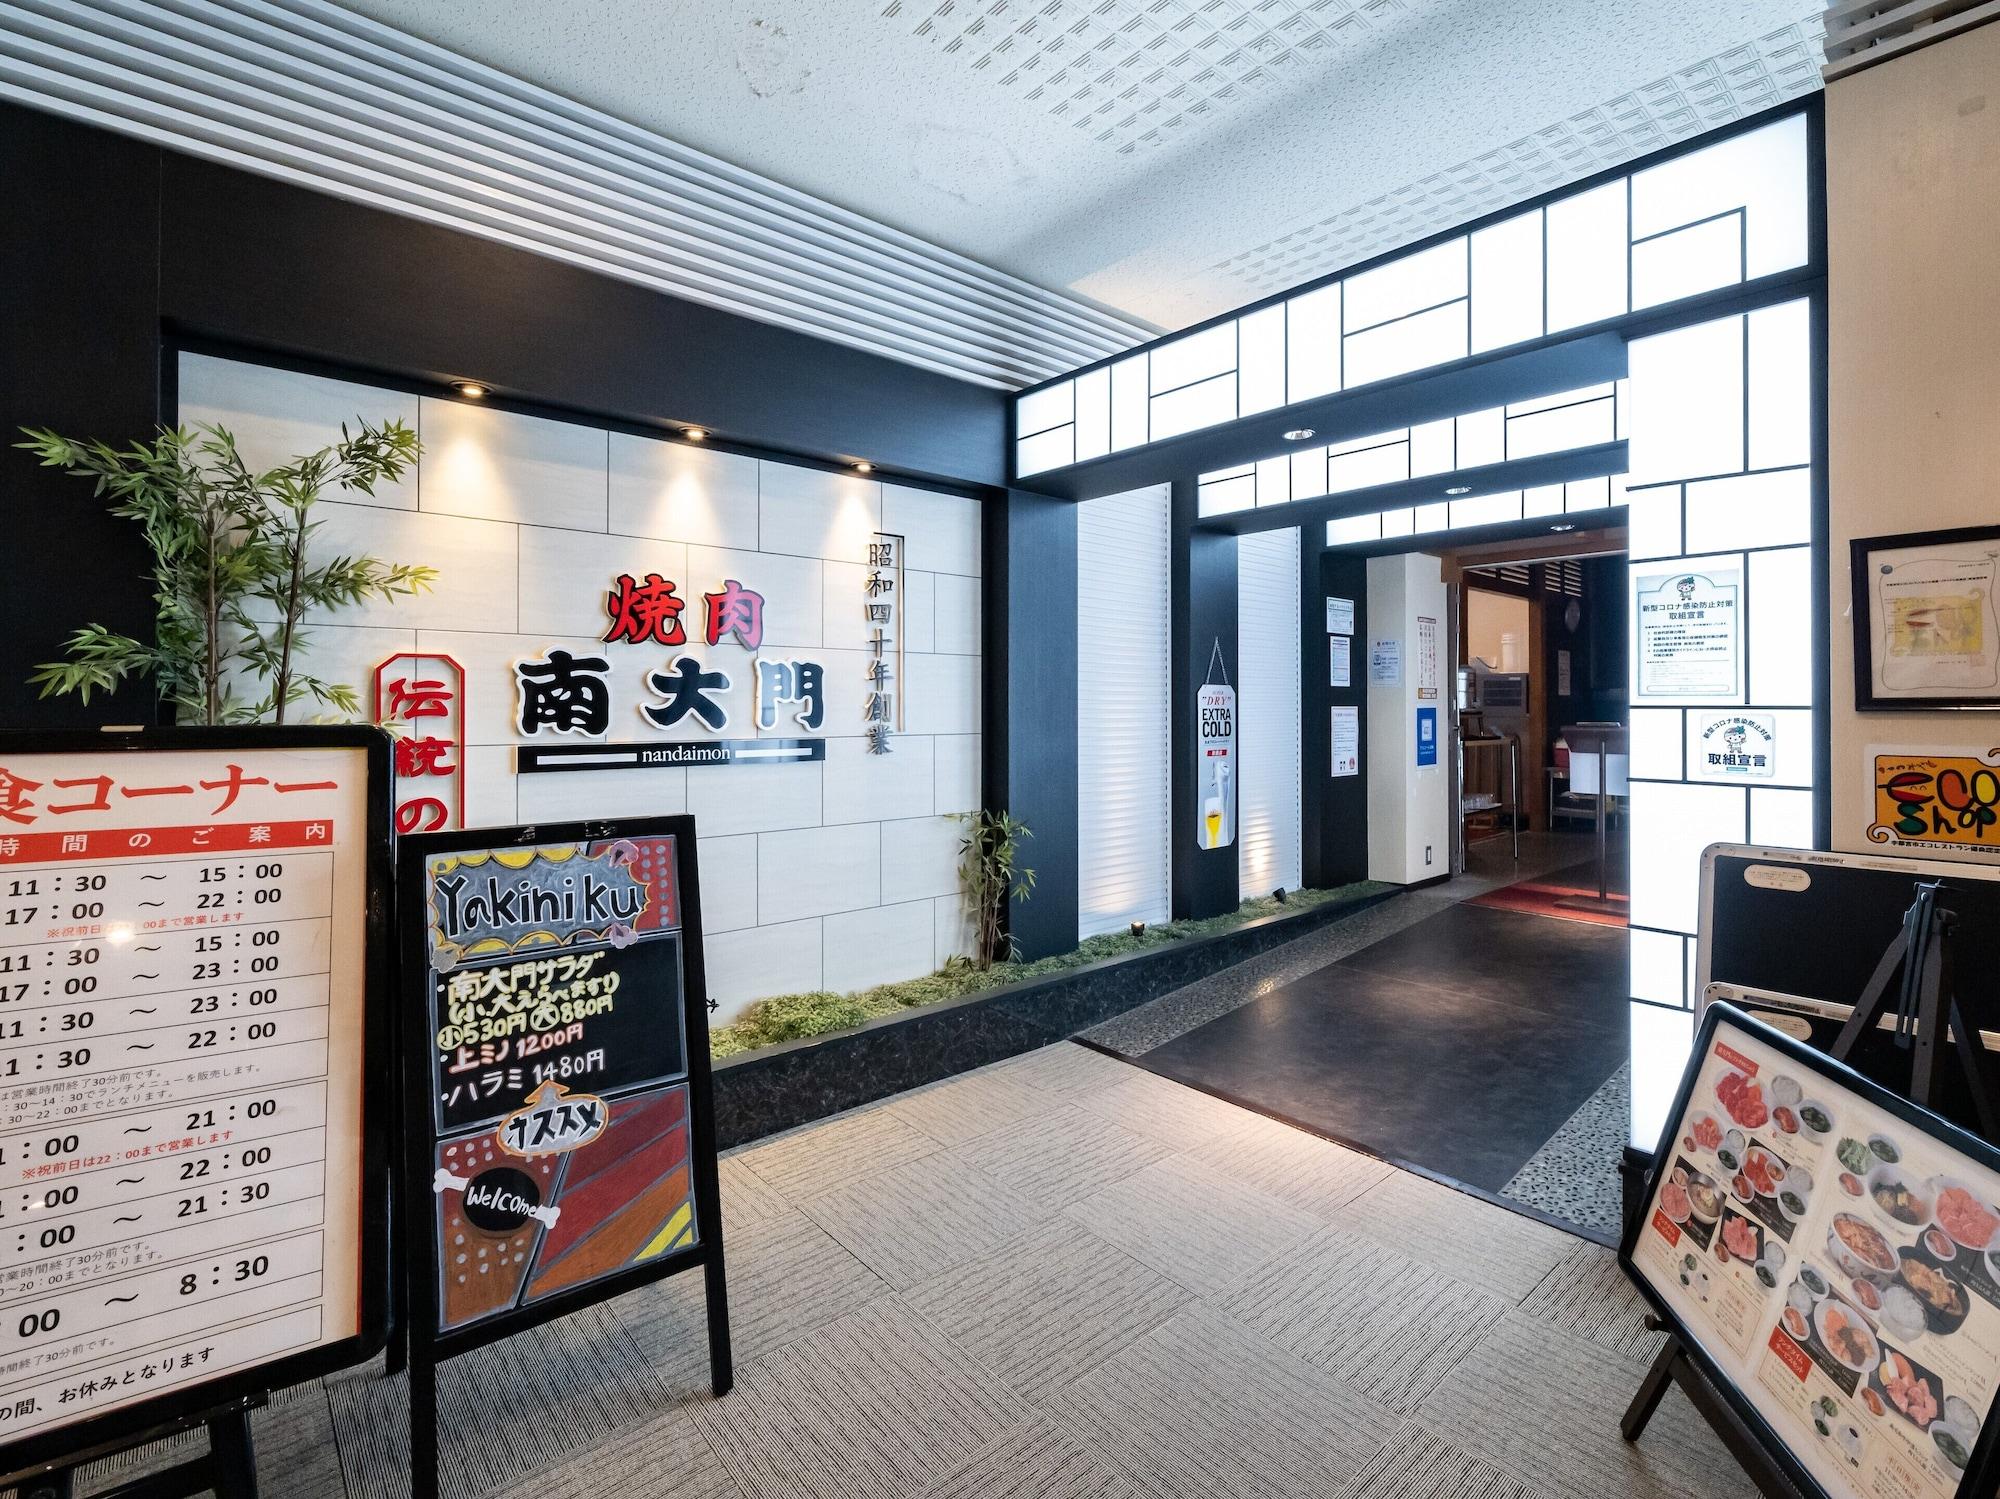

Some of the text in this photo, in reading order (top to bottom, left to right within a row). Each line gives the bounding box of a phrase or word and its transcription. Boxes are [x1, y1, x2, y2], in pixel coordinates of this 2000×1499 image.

[602, 572, 766, 651] 焼肉
[1669, 610, 1705, 620] 取組宣言
[864, 542, 895, 756] 昭和四十年創業
[512, 645, 826, 738] 南大門
[1202, 708, 1232, 721] EXTRA
[388, 677, 457, 834] 伝統の
[641, 746, 732, 764] nandaimon
[1202, 721, 1232, 738] COLD
[1708, 753, 1767, 767] 取組宣言
[447, 951, 606, 1007] 南大門サラダ
[516, 1022, 585, 1060] 1200円
[449, 1049, 605, 1107] ハラミ 1480円
[505, 1100, 602, 1151] オススメ
[58, 1347, 215, 1404] お休みとなります
